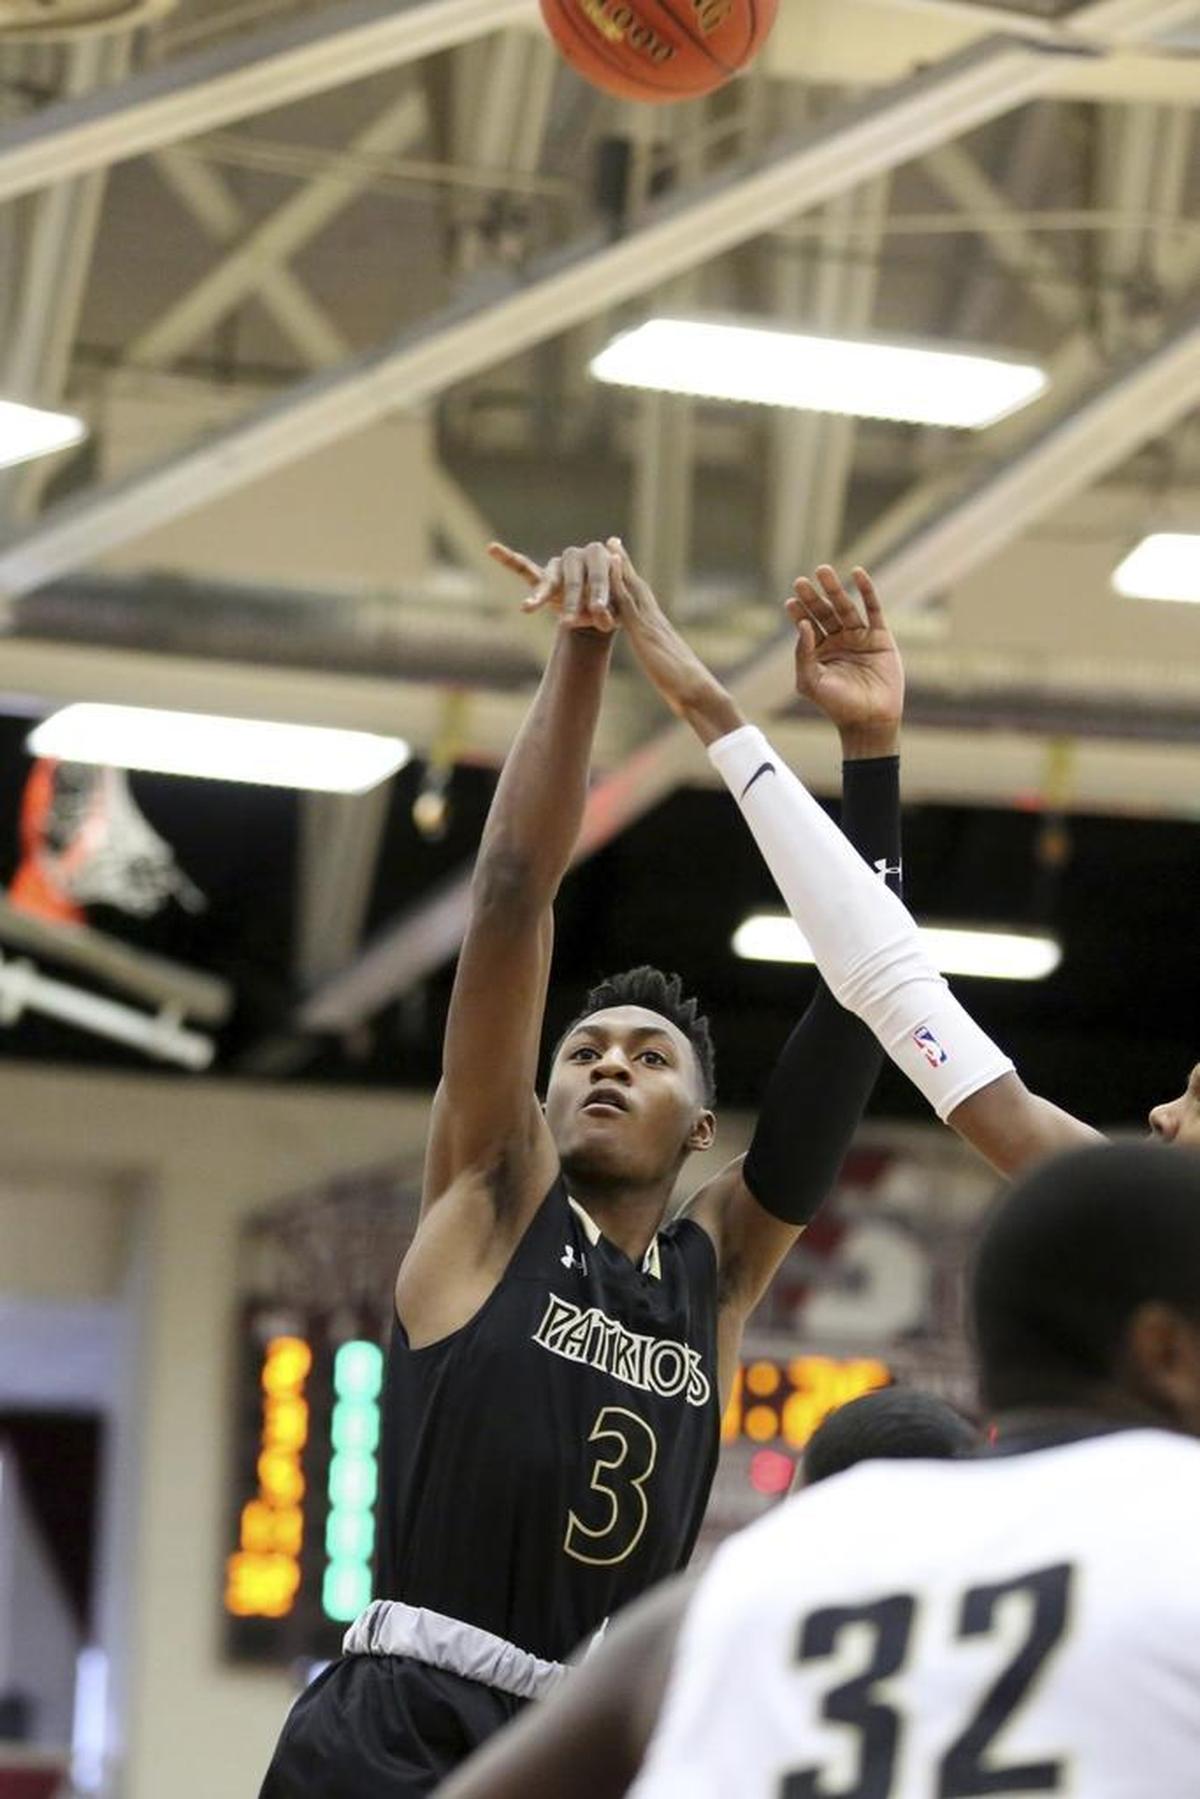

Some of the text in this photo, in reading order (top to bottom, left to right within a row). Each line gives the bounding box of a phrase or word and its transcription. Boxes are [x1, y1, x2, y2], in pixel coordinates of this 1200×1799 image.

[531, 1292, 711, 1406] PATRIOS
[563, 1406, 658, 1566] 3
[779, 1559, 1076, 1799] 32
